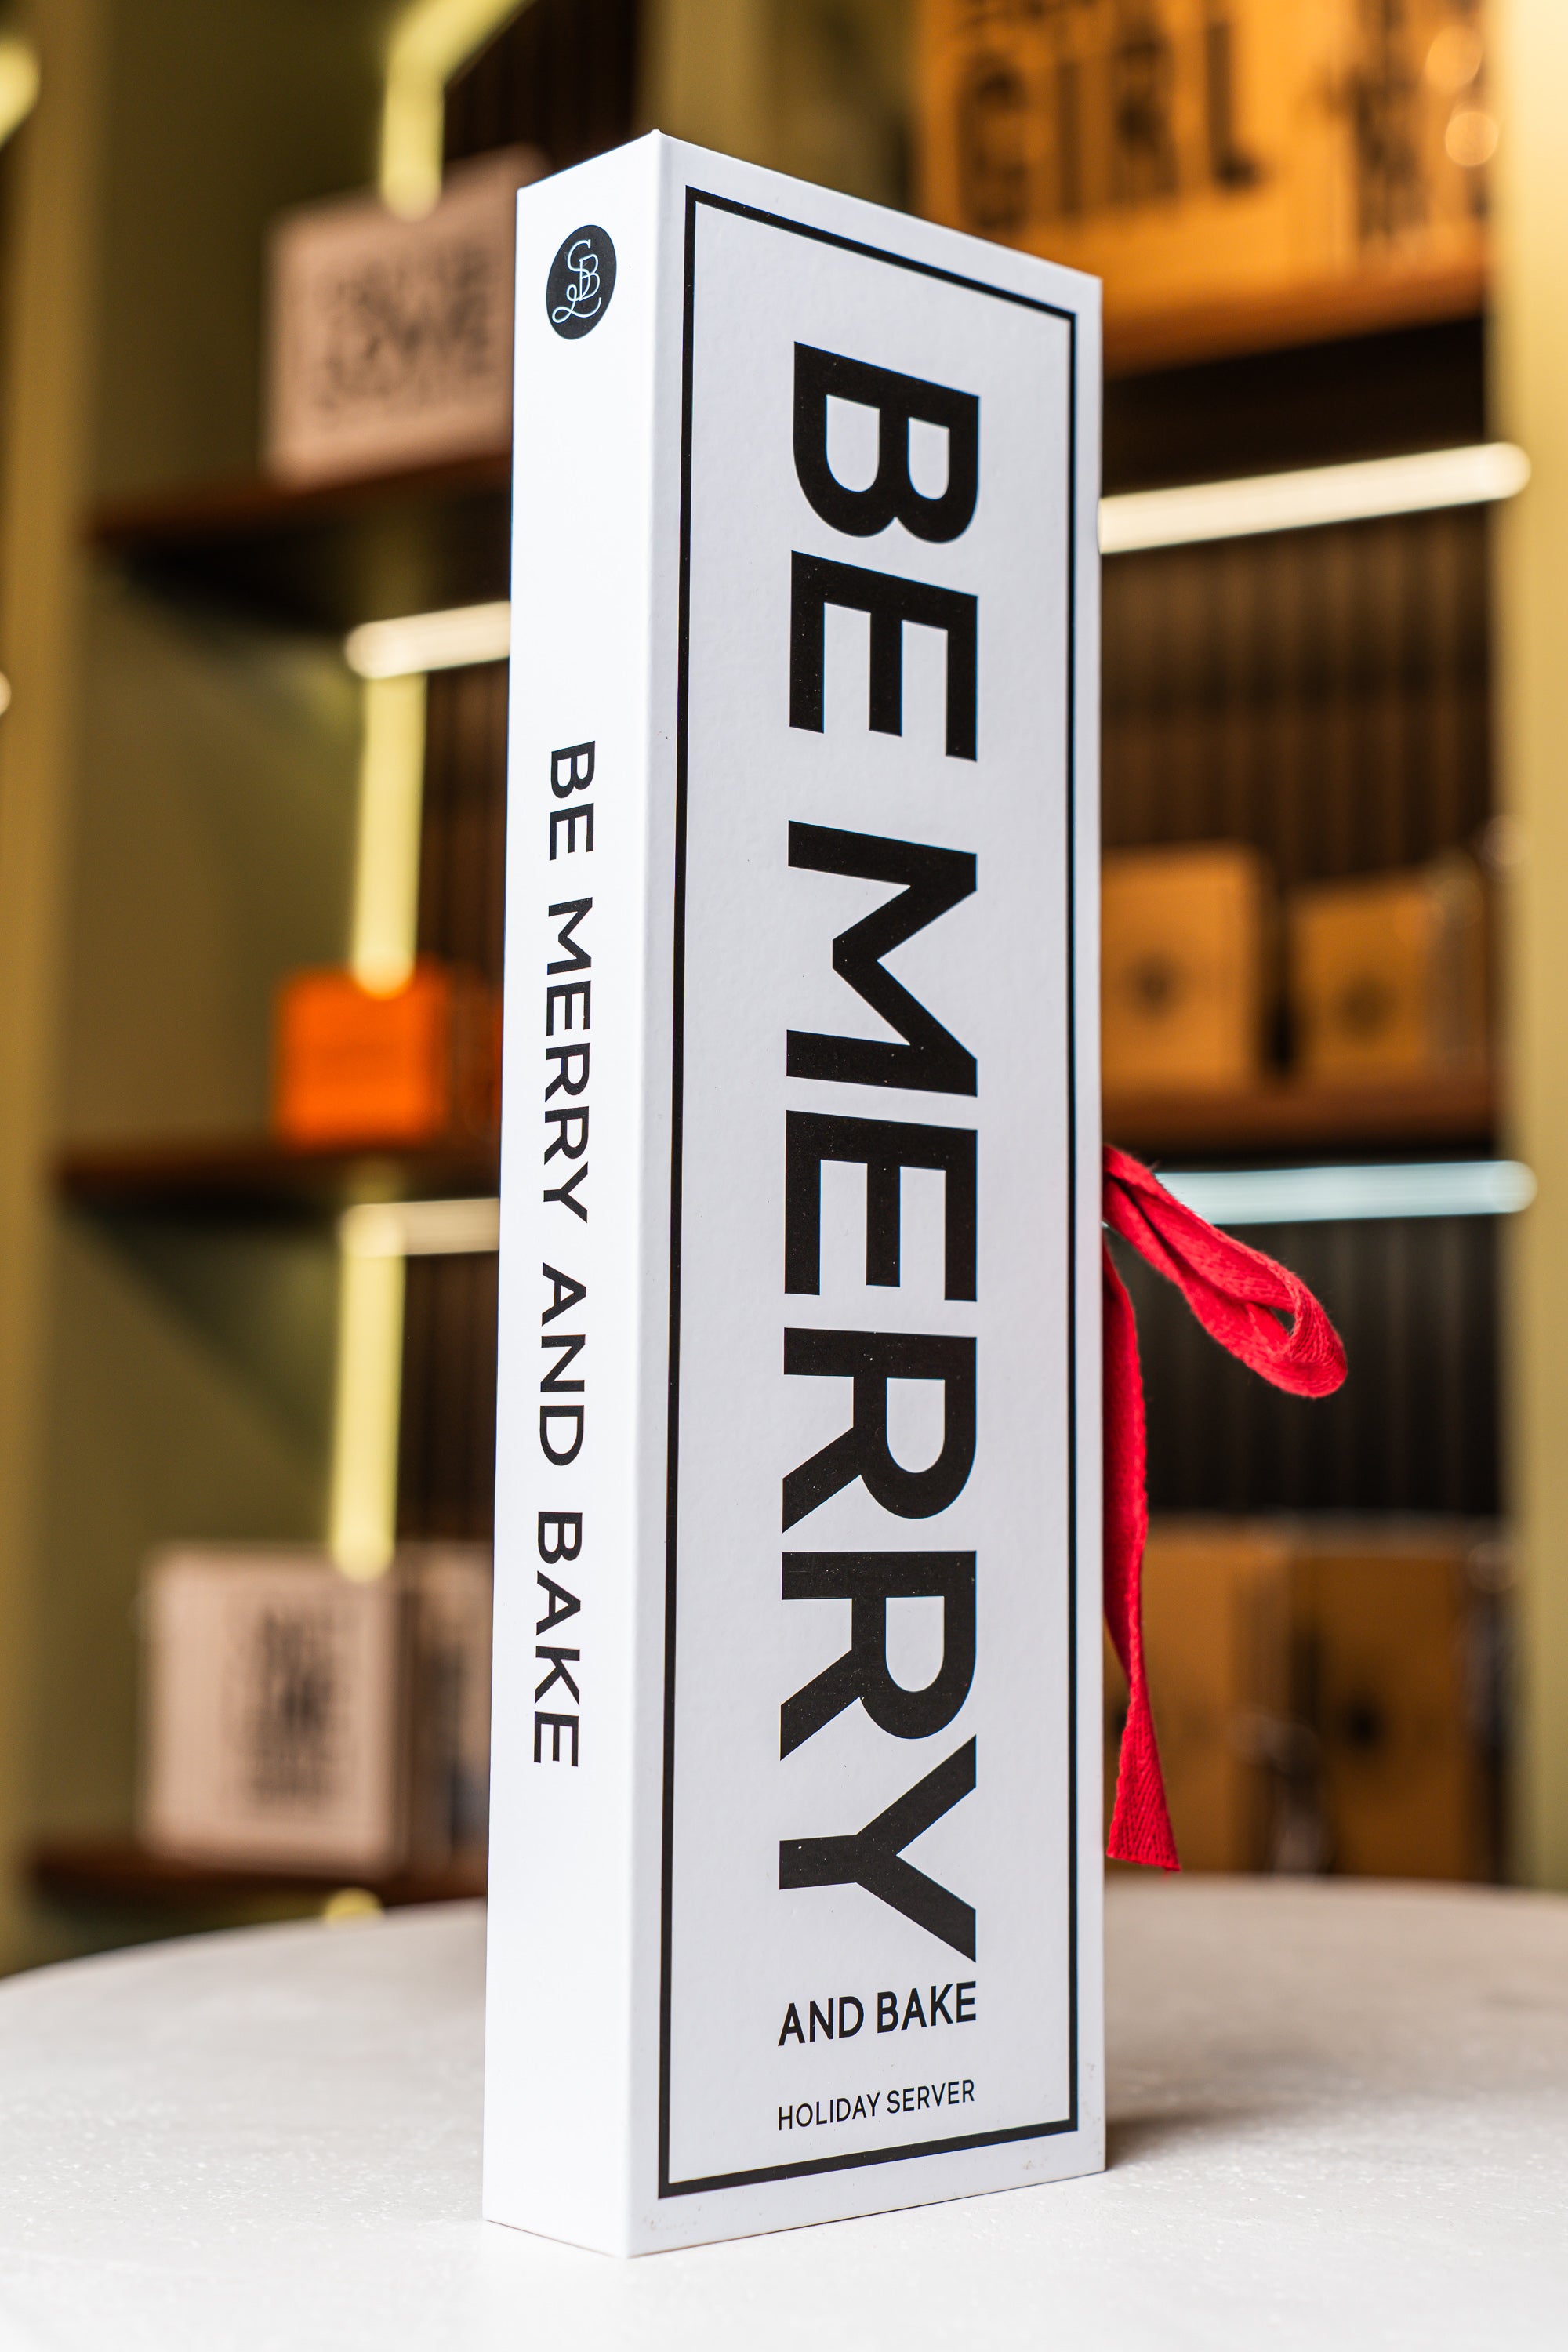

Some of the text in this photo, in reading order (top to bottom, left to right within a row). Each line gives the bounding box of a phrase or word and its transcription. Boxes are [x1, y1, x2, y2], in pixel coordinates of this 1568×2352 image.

[533, 740, 596, 1767] BE MERRY AND BAKE
[779, 342, 979, 1963] BE MERRY
[777, 1980, 976, 2047] AND BAKE
[778, 2079, 975, 2131] HOLIDAY SERVER
